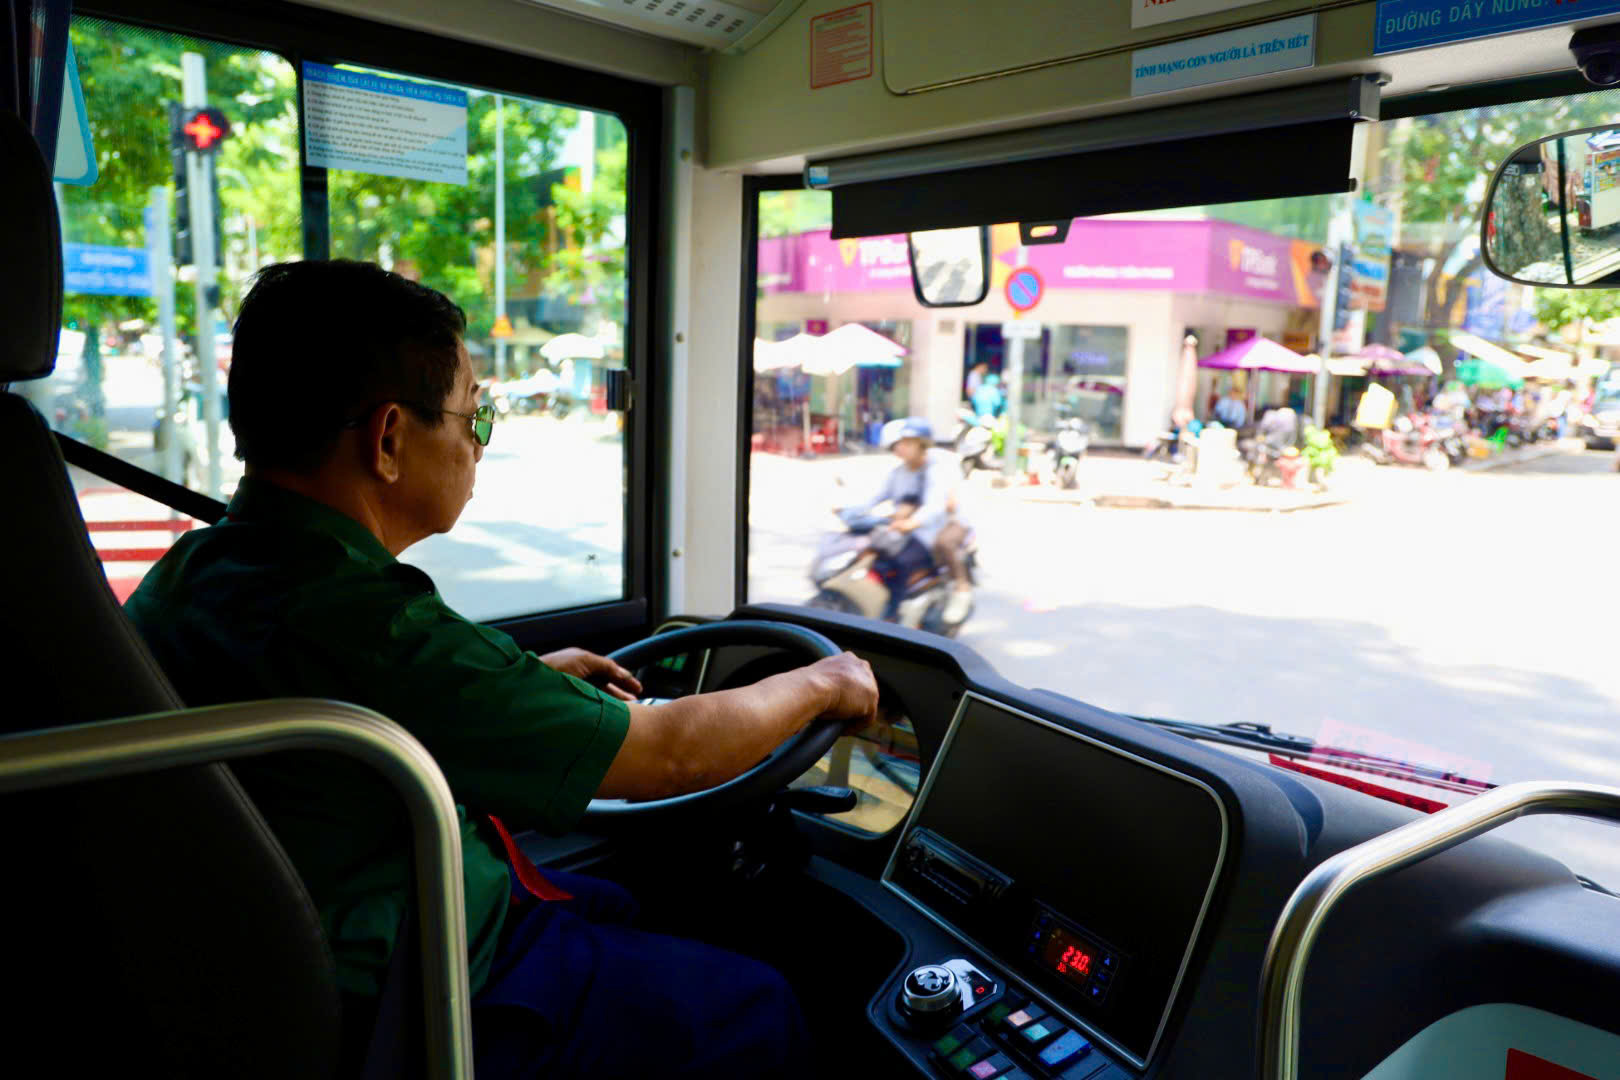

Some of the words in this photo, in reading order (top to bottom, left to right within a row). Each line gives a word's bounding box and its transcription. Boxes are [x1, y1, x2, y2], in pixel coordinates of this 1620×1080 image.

[1385, 9, 1441, 34] ĐƯỜNG
[1449, 0, 1484, 23] DÂY
[1158, 59, 1185, 74] MẠNG
[1187, 55, 1207, 69] CON
[1257, 38, 1285, 54] TRÊN
[1287, 32, 1309, 49] HẾT
